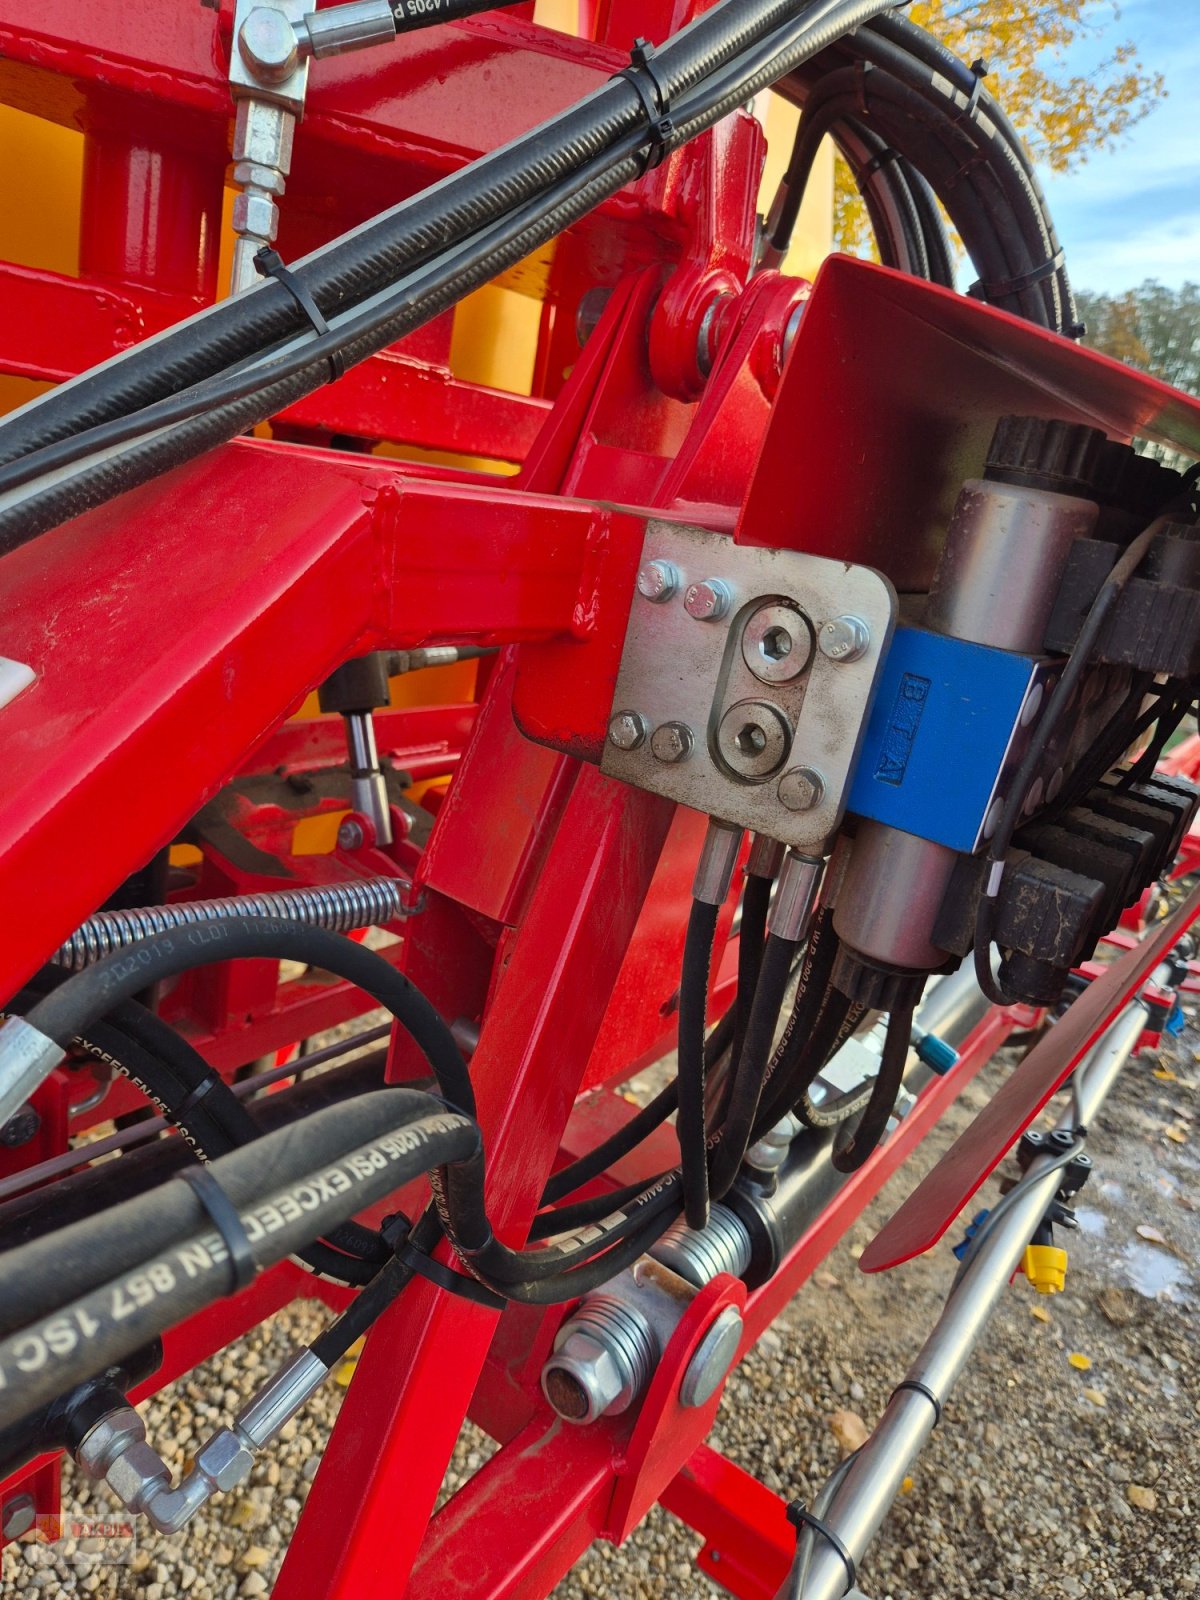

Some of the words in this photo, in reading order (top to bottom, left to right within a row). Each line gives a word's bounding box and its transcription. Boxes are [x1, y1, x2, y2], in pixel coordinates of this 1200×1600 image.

[345, 1148, 388, 1181] PSI
[111, 1262, 176, 1322] 857
[12, 1307, 100, 1373] 1SC
